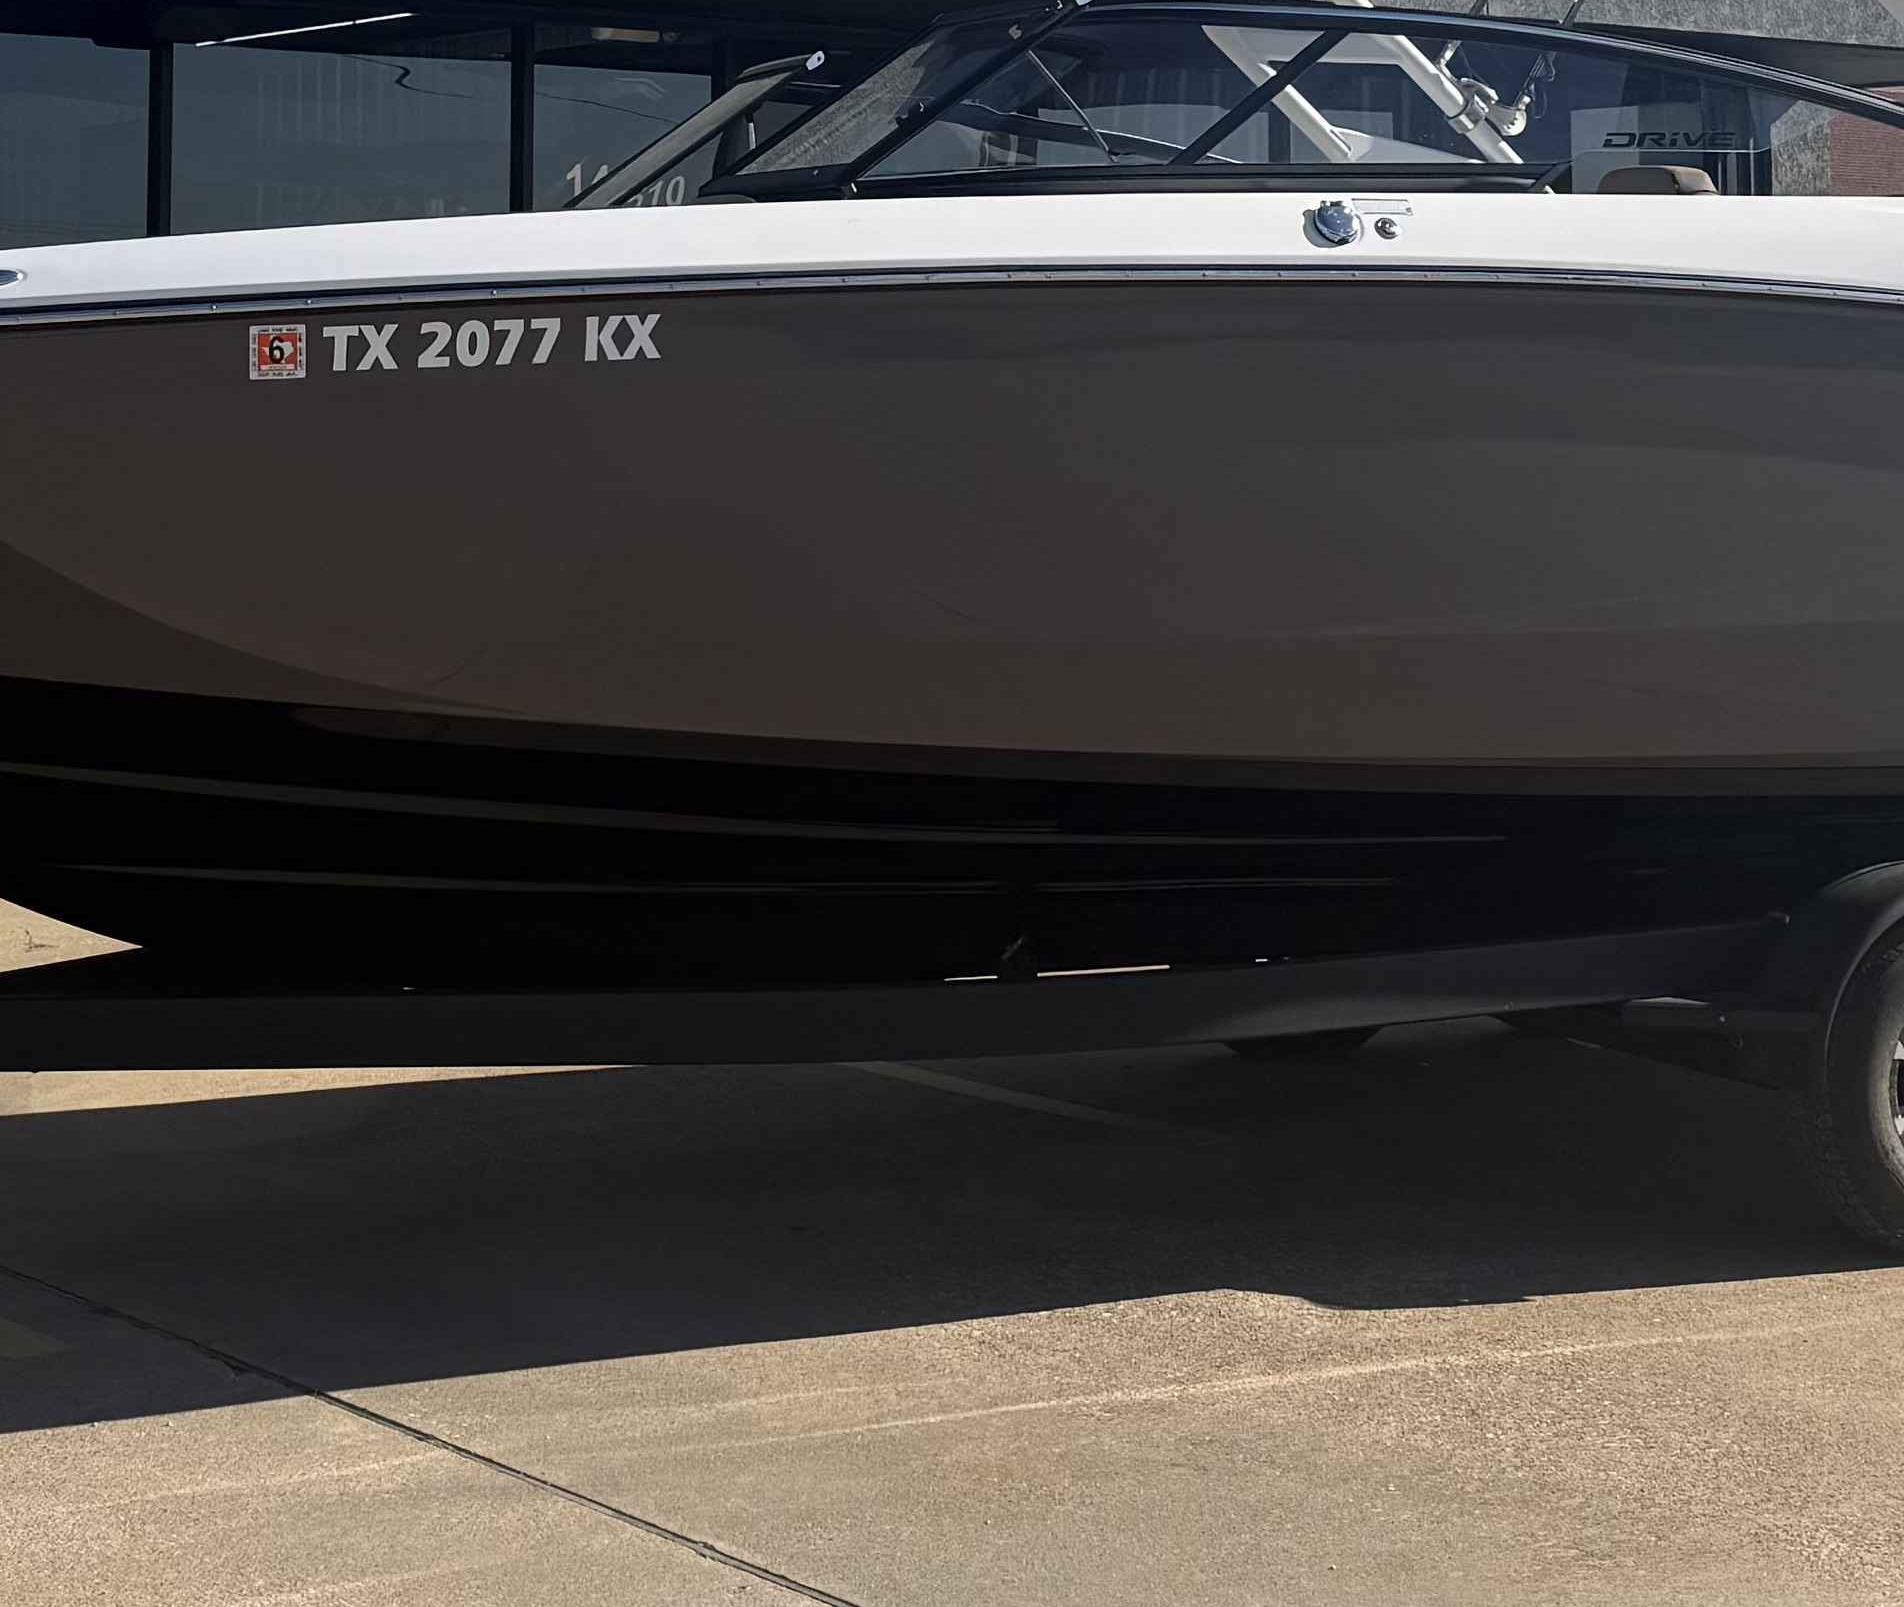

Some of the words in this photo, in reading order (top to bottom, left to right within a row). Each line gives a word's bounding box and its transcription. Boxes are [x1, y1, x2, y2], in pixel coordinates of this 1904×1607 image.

[322, 323, 399, 371] TX
[417, 316, 562, 369] 2077
[584, 313, 663, 362] KX
